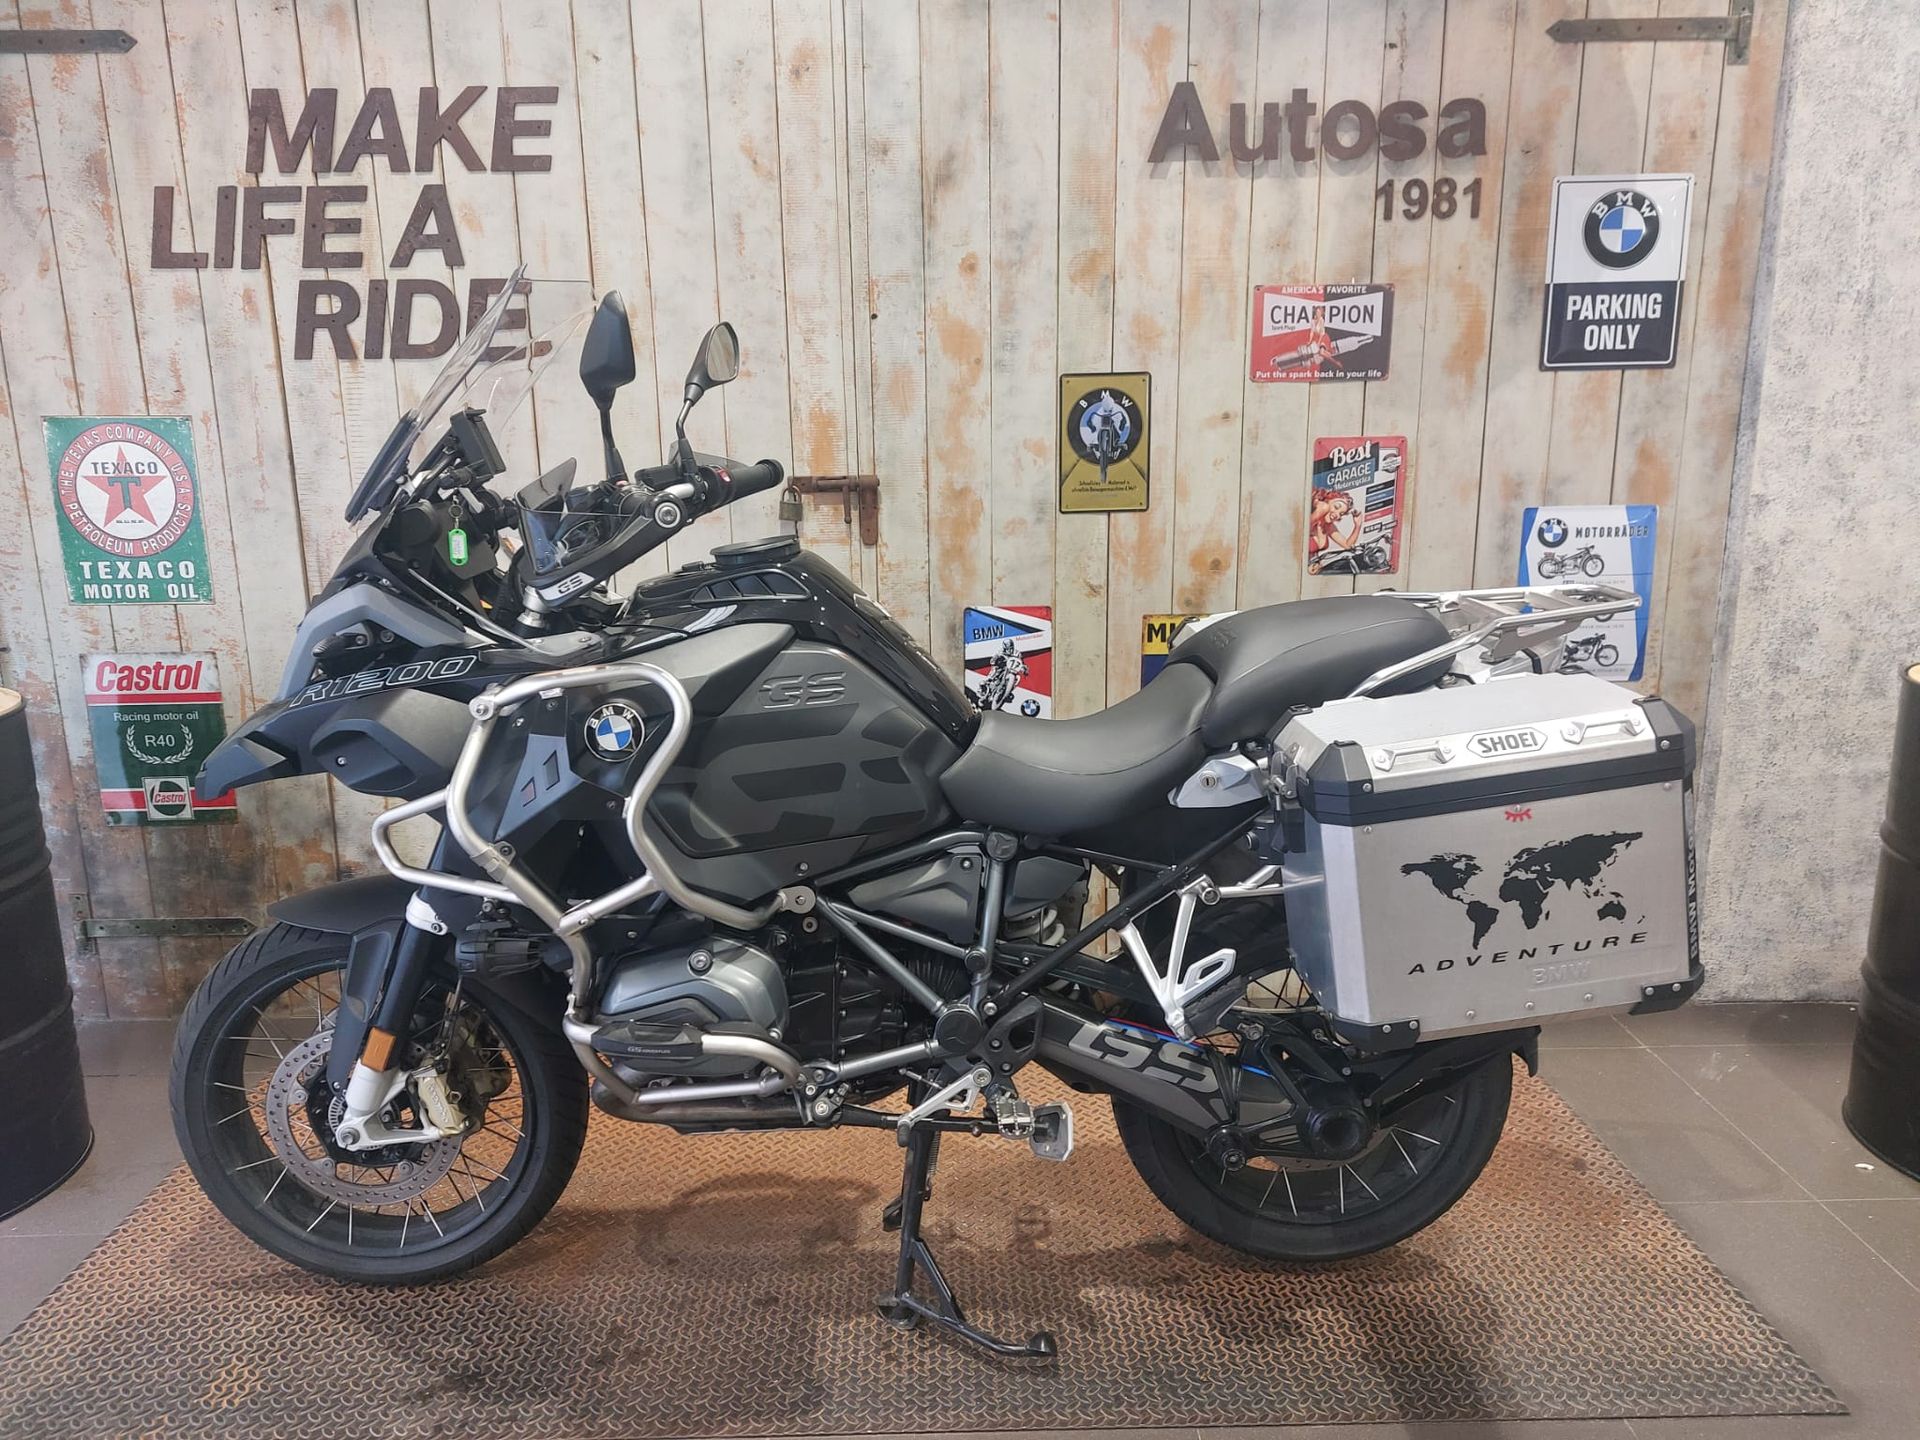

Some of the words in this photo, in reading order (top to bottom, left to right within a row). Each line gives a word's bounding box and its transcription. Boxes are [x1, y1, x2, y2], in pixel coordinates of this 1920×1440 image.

[245, 85, 559, 173] MAKE
[1147, 81, 1487, 163] Autosa
[1375, 177, 1483, 221] 1981
[1591, 191, 1656, 219] BMW
[151, 185, 368, 269] LIFE
[390, 184, 465, 267] A
[1281, 286, 1324, 294] AMERICA'S
[1327, 285, 1367, 294] FAVORITE
[294, 278, 552, 361] RIDE
[1566, 293, 1663, 323] PARKING
[1583, 323, 1639, 352] ONLY
[1289, 371, 1312, 380] spark
[1346, 372, 1365, 380] your
[1079, 390, 1133, 408] BMW
[64, 431, 101, 467] TEXAS
[106, 426, 172, 459] COMPANY
[1329, 440, 1371, 467] Best
[91, 462, 158, 475] TEXACO
[1327, 462, 1371, 485] GARAGE
[61, 471, 76, 496] THE
[67, 502, 134, 555] PETROLEUM
[142, 502, 191, 555] PRODUCTS
[1575, 525, 1649, 538] MOTORRÄDER
[80, 561, 195, 579] TEXACO
[84, 583, 150, 599] MOTOR
[168, 583, 199, 599] OIL
[558, 575, 583, 594] GS
[973, 624, 1004, 640] BMW
[95, 660, 203, 692] Castrol
[290, 655, 477, 708] R1200
[759, 672, 847, 708] GS
[113, 712, 150, 722] Racing
[153, 712, 183, 721] motor
[186, 711, 199, 720] oil
[589, 706, 634, 729] BMW
[144, 734, 175, 747] R40
[1477, 731, 1539, 754] SHOEI
[154, 792, 187, 803] Castrol
[1408, 931, 1648, 975] ADVENTURE
[1068, 1022, 1219, 1093] GS
